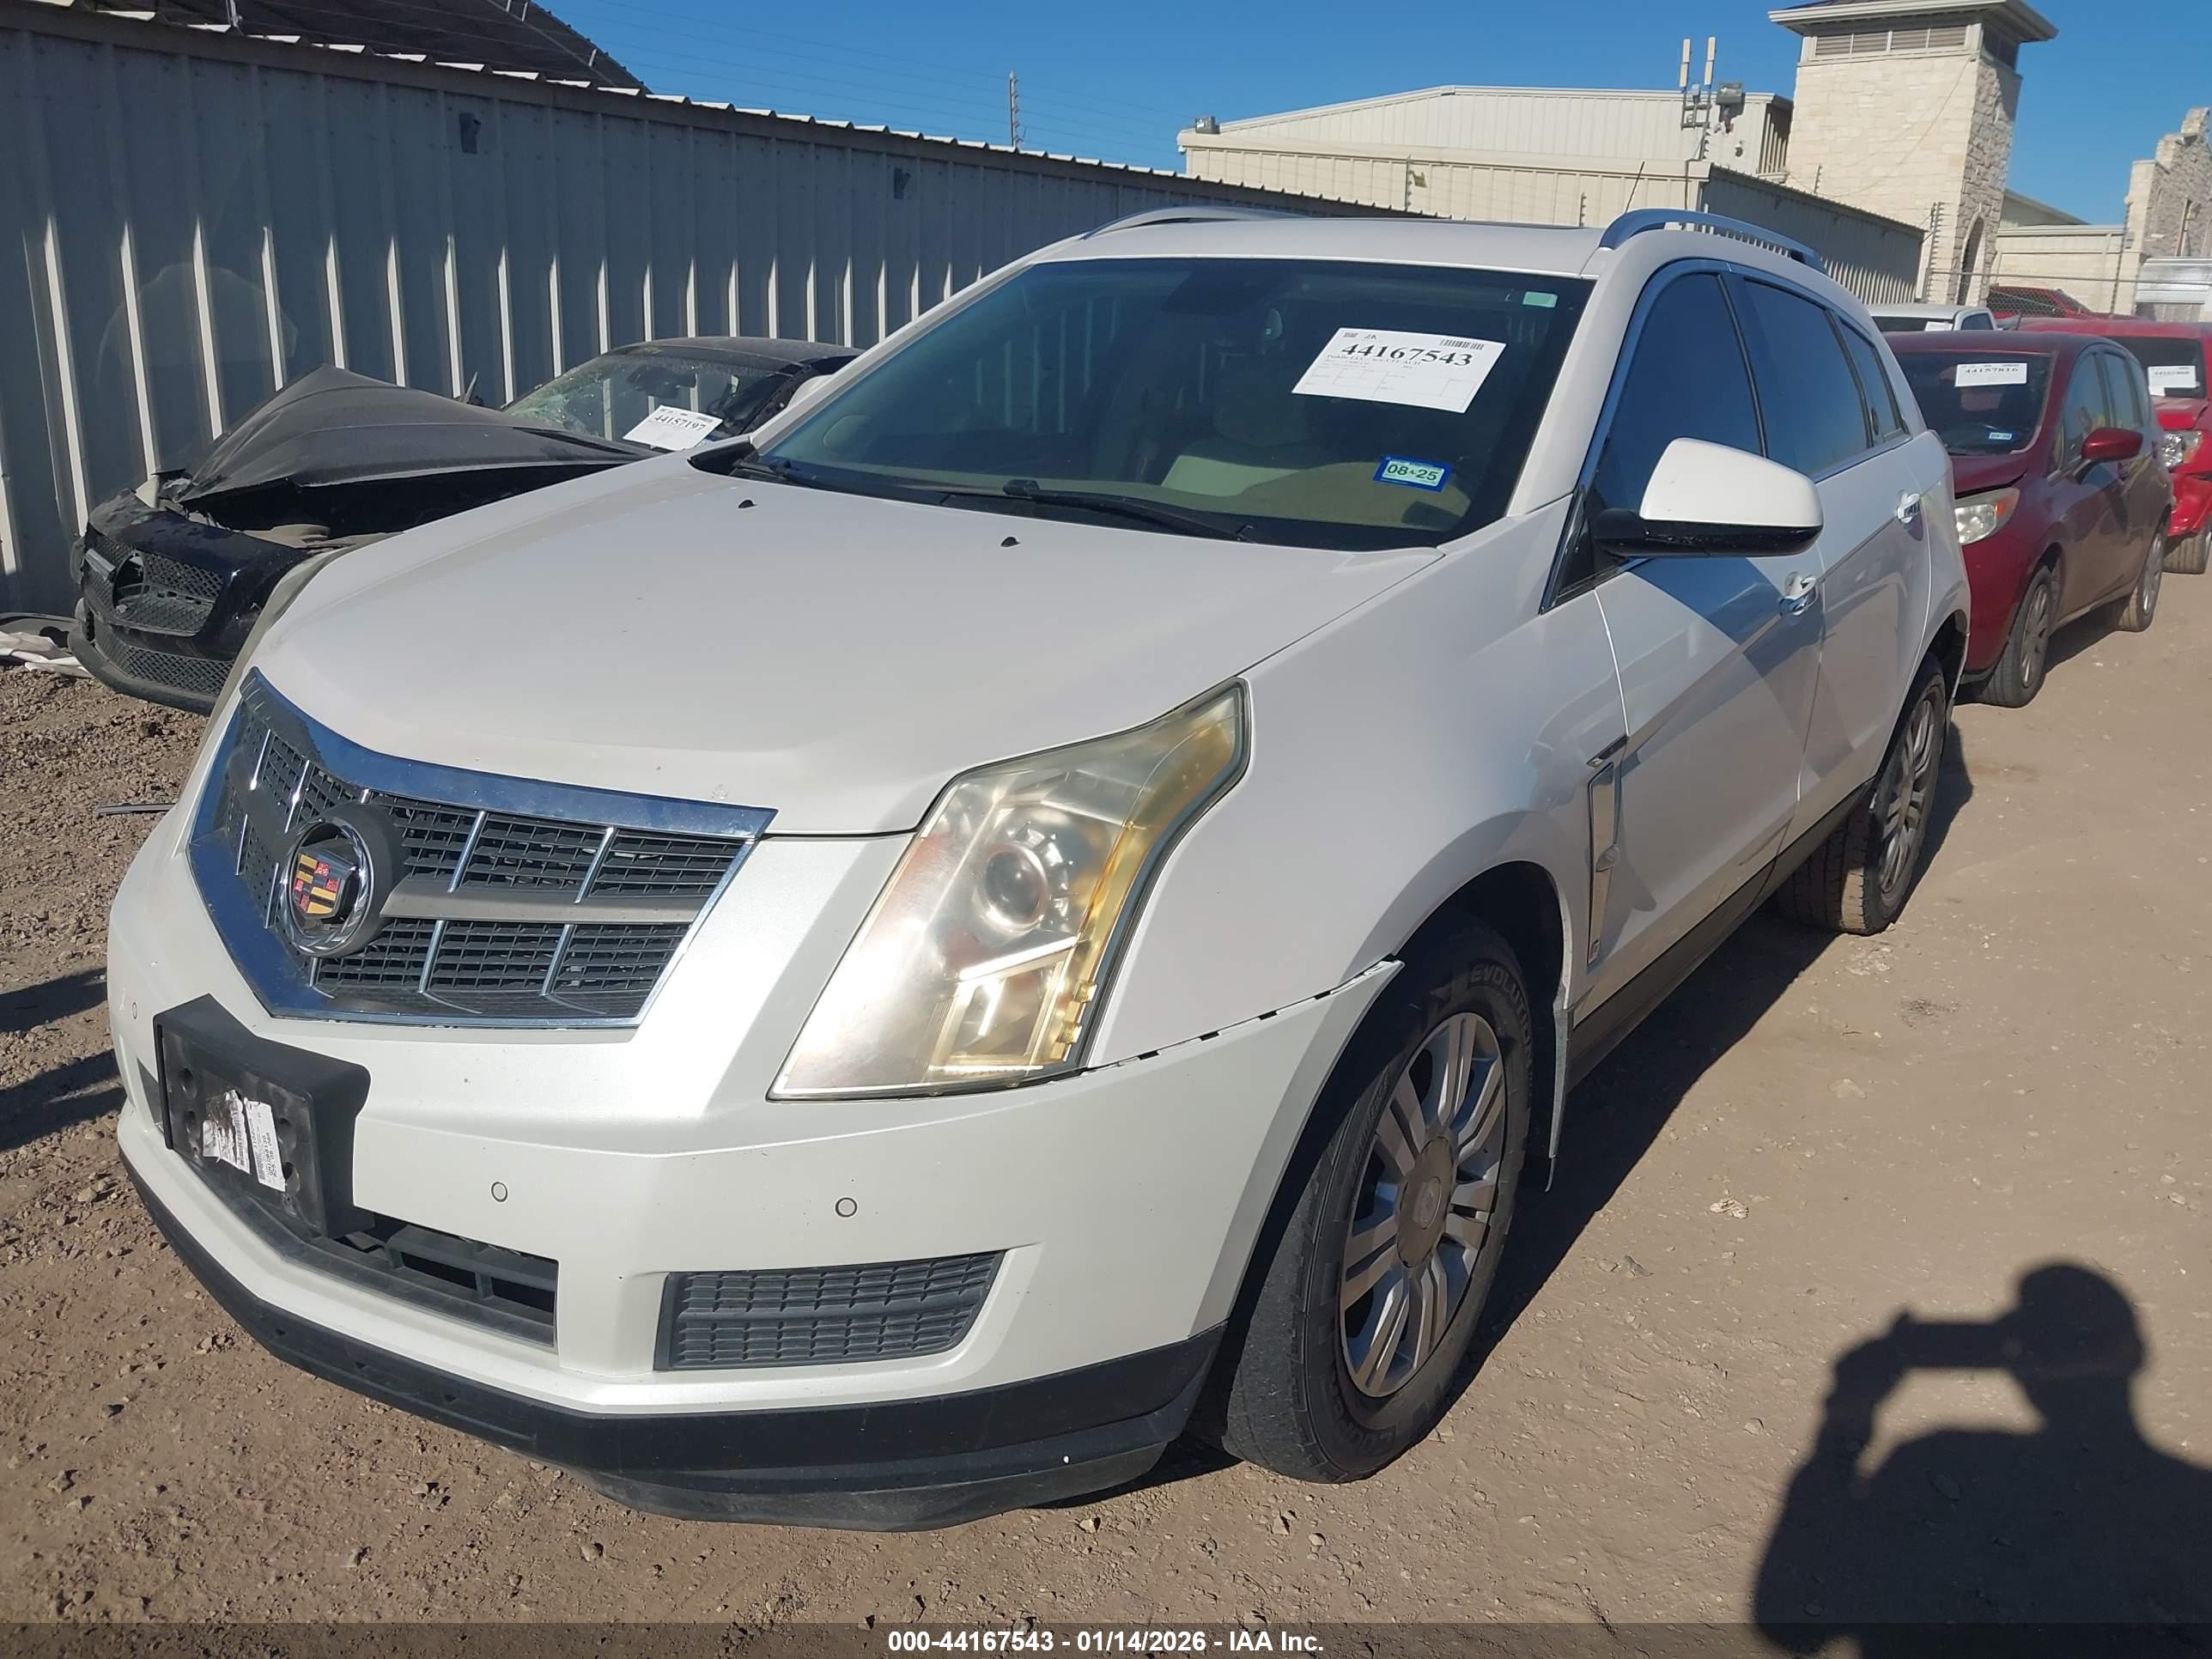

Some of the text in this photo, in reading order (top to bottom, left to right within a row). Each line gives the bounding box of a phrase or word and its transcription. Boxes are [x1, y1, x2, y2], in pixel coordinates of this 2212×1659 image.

[1341, 343, 1473, 367] 44167543
[654, 415, 707, 431] 44157197
[1387, 464, 1408, 476] 08
[1415, 469, 1439, 481] 25
